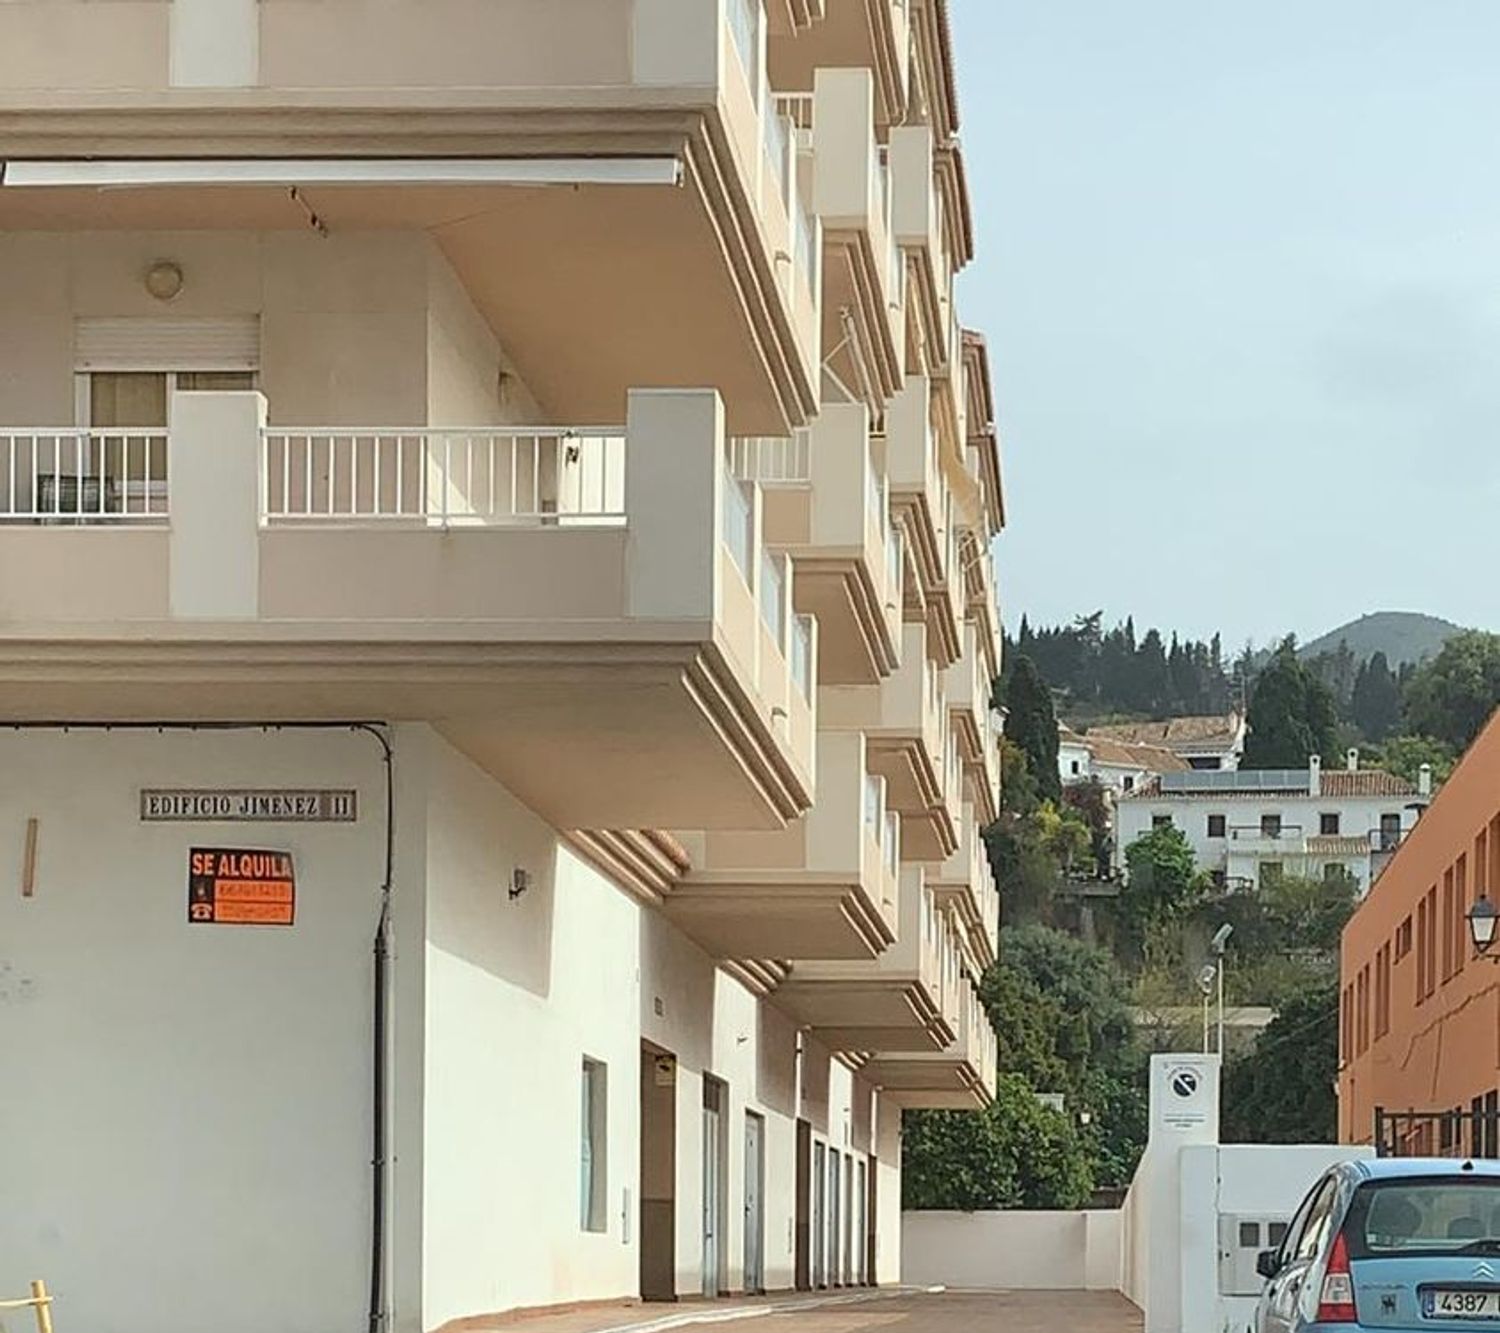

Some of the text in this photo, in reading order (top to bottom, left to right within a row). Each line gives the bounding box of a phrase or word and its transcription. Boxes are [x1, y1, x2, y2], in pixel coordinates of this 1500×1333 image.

[150, 796, 231, 815] EDIFICIO
[239, 796, 318, 815] JIMENEZ
[192, 853, 293, 878] SE ALQUILA
[1440, 1293, 1487, 1313] 4387
